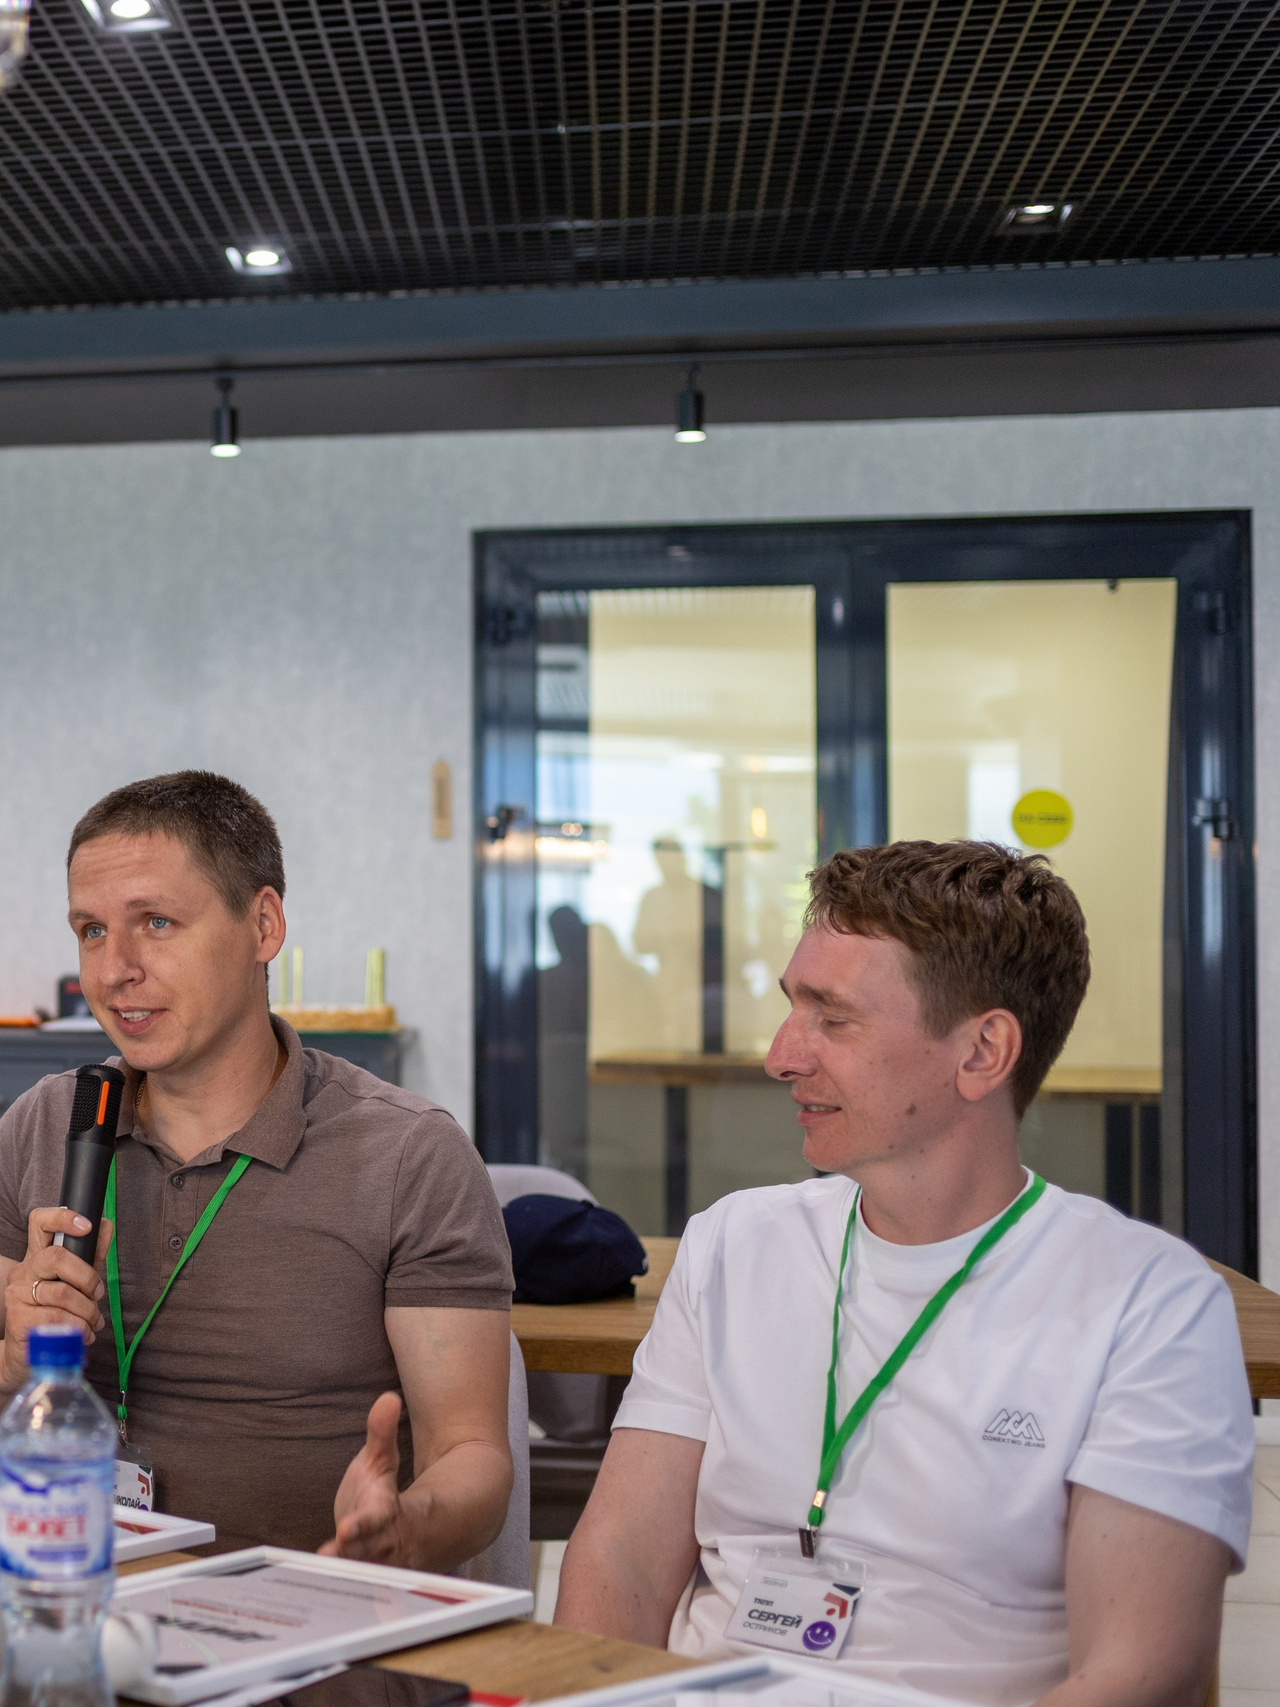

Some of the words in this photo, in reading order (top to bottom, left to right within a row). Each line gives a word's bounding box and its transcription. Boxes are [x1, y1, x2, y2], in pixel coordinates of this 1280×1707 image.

[982, 1434, 1022, 1446] CONEXTWO
[1023, 1441, 1046, 1449] JEANS
[114, 1494, 141, 1509] ИКОЛАЙ
[748, 1608, 803, 1628] СЕРГЕЙ
[742, 1621, 788, 1636] ОСТРИКОВ
